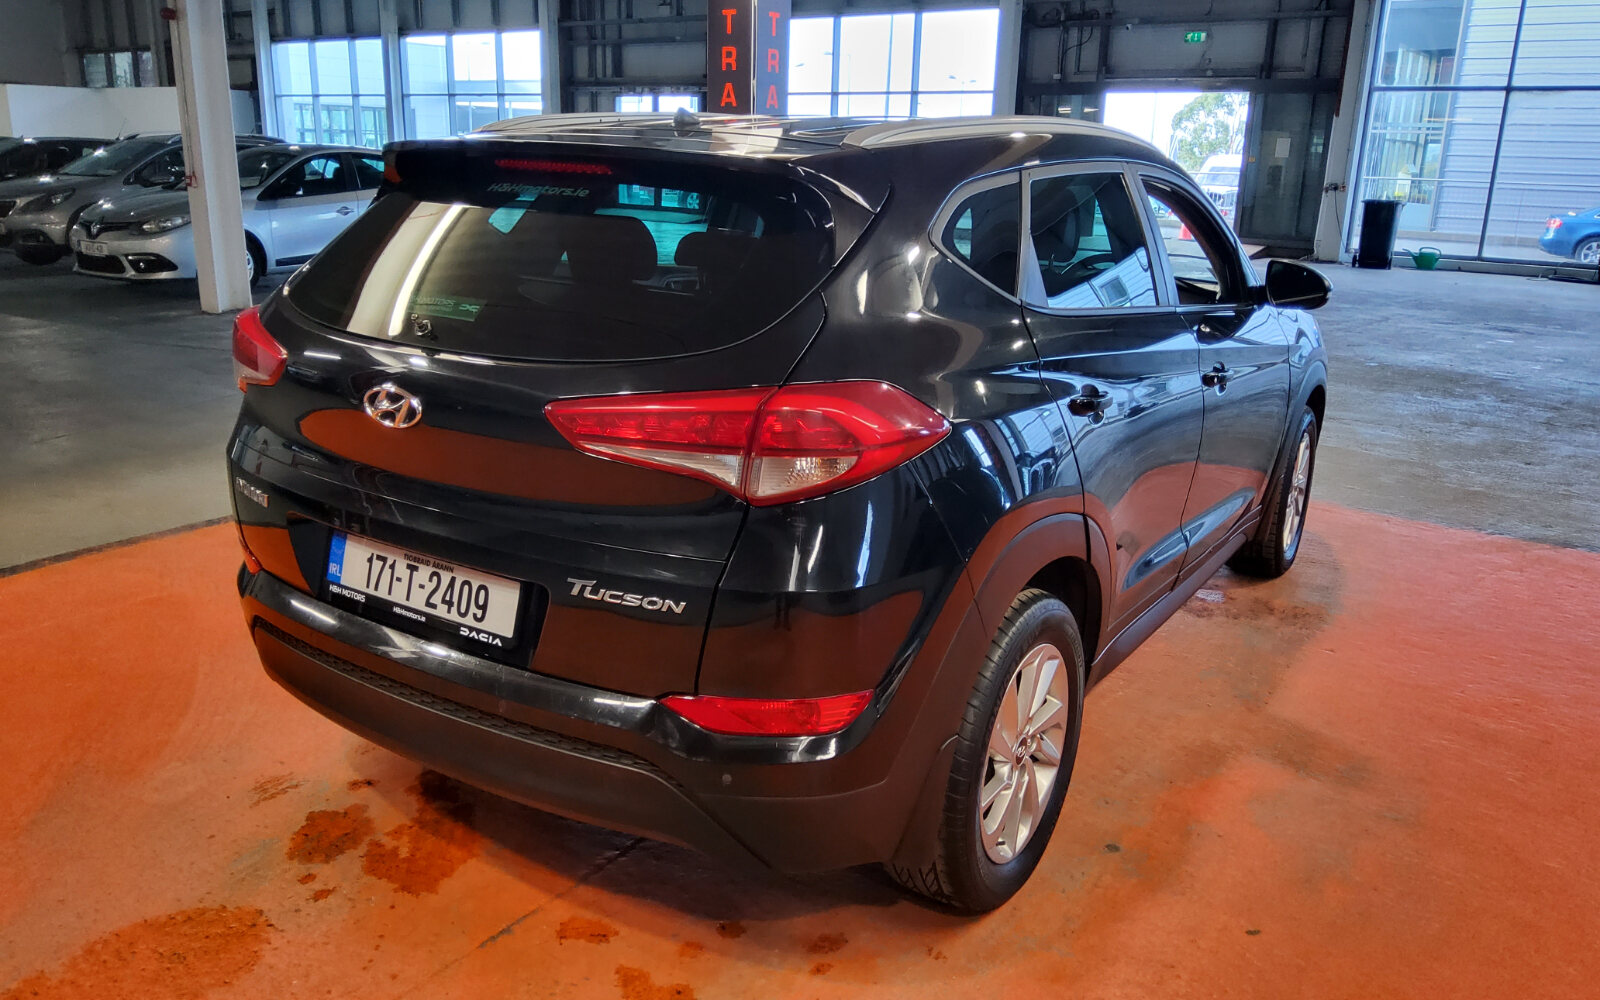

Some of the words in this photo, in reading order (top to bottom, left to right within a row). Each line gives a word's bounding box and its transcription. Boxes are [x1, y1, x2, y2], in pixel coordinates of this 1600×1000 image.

[329, 562, 341, 577] IRL
[341, 588, 366, 602] MOTORS
[366, 552, 490, 624] 171-T-2409
[459, 626, 502, 647] DACIA
